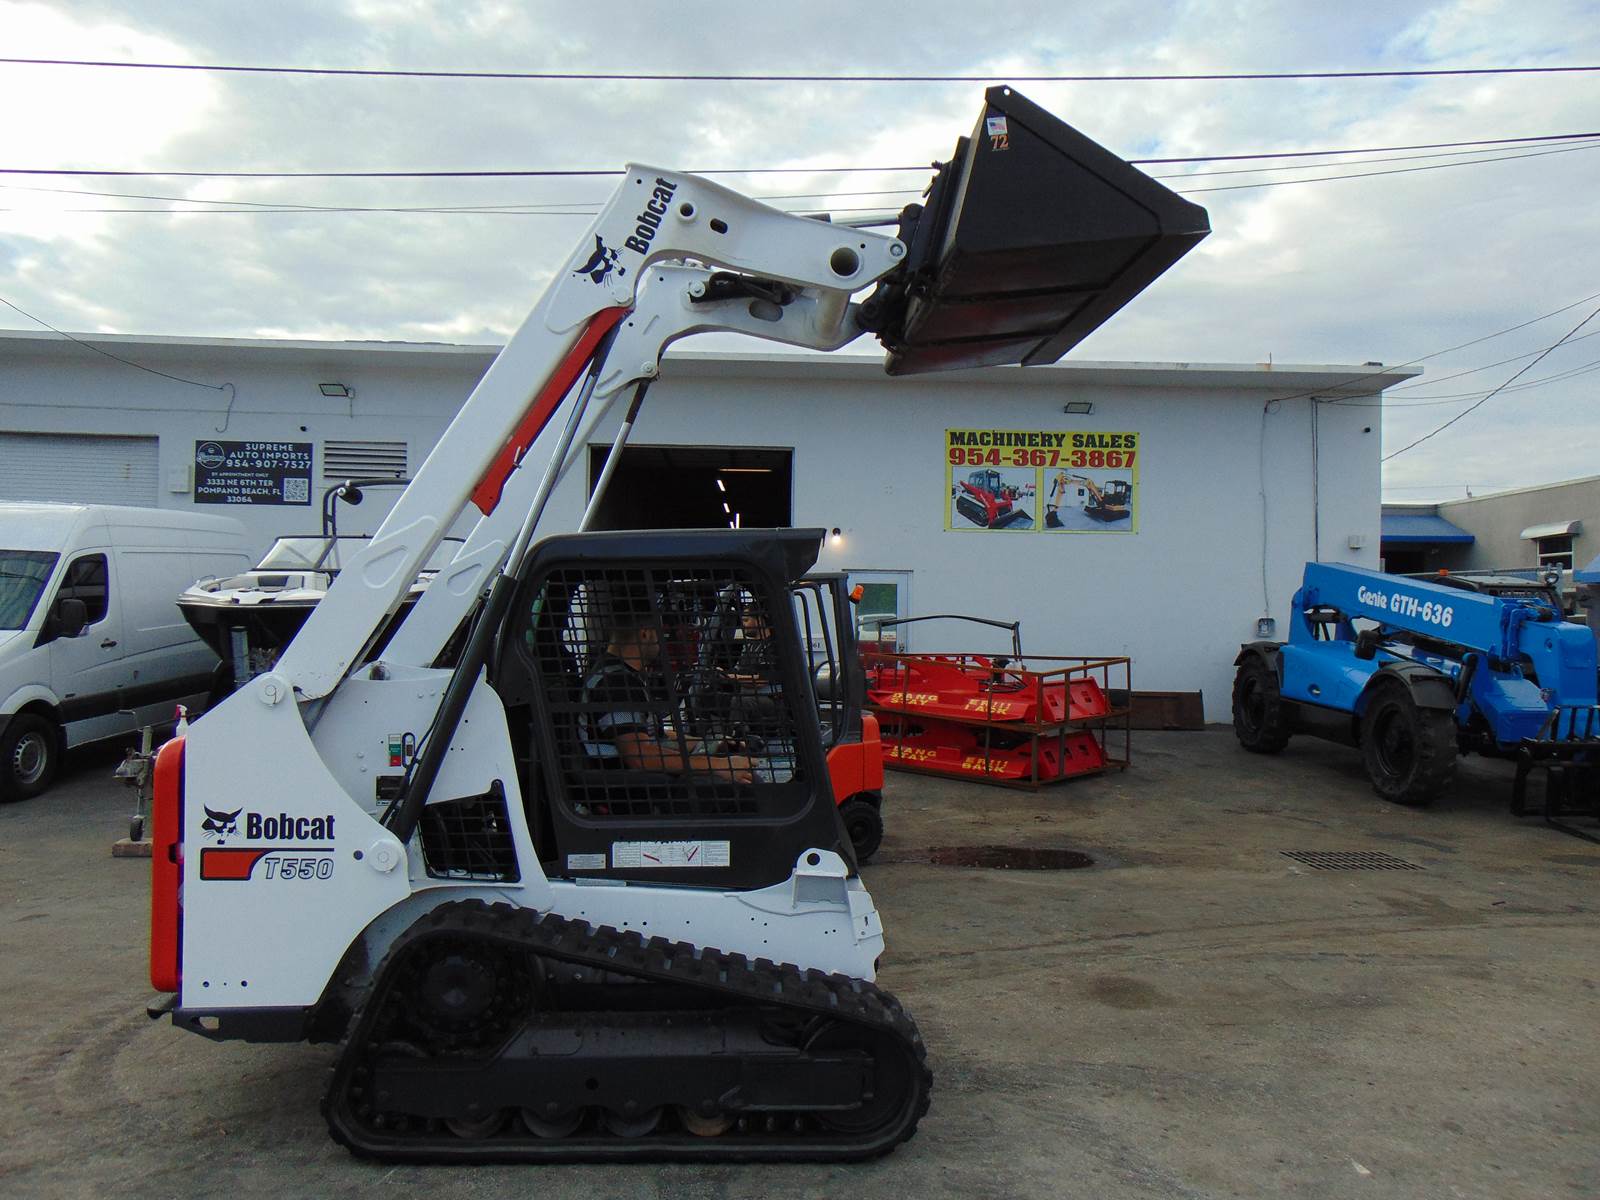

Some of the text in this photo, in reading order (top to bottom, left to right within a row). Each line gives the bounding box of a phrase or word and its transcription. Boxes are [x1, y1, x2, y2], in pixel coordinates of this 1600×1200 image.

[991, 135, 1009, 150] 72
[624, 177, 678, 256] Bobcat
[246, 443, 294, 452] SUPREME
[950, 431, 1136, 449] MACHINERY SALES
[229, 451, 259, 459] AUTO
[262, 452, 309, 460] IMPORTS
[949, 447, 1136, 468] 954-367-3867
[226, 459, 312, 469] 954-907-7527
[207, 478, 225, 486] 3333
[198, 486, 282, 496] POMPANO BEACH, FL
[227, 495, 252, 503] 33064
[1357, 585, 1453, 628] Genie GTH-636
[246, 812, 336, 840] Bobcat
[264, 857, 334, 880] T550
